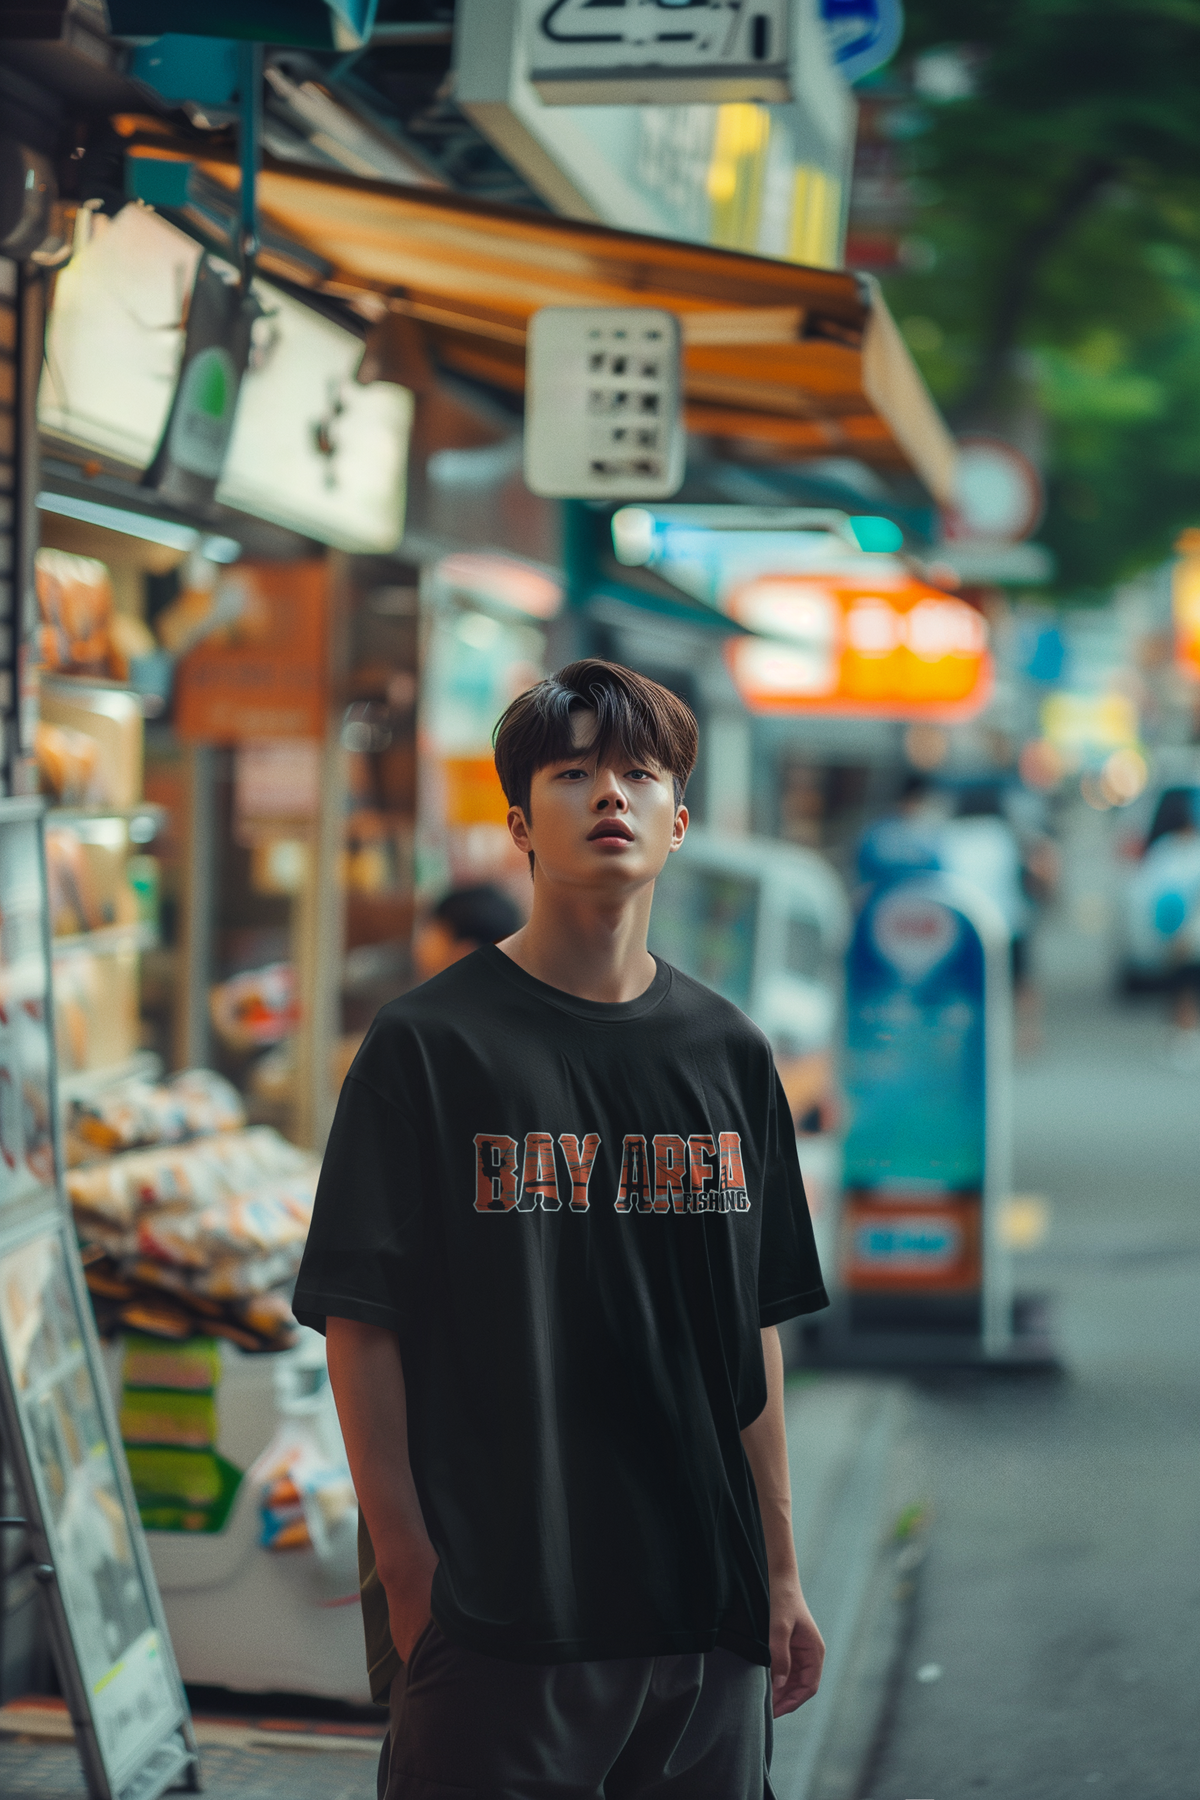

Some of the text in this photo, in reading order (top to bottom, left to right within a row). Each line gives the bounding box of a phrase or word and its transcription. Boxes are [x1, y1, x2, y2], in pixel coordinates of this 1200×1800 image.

[473, 1132, 750, 1213] BAY AREA
[682, 1190, 747, 1212] FISHING
